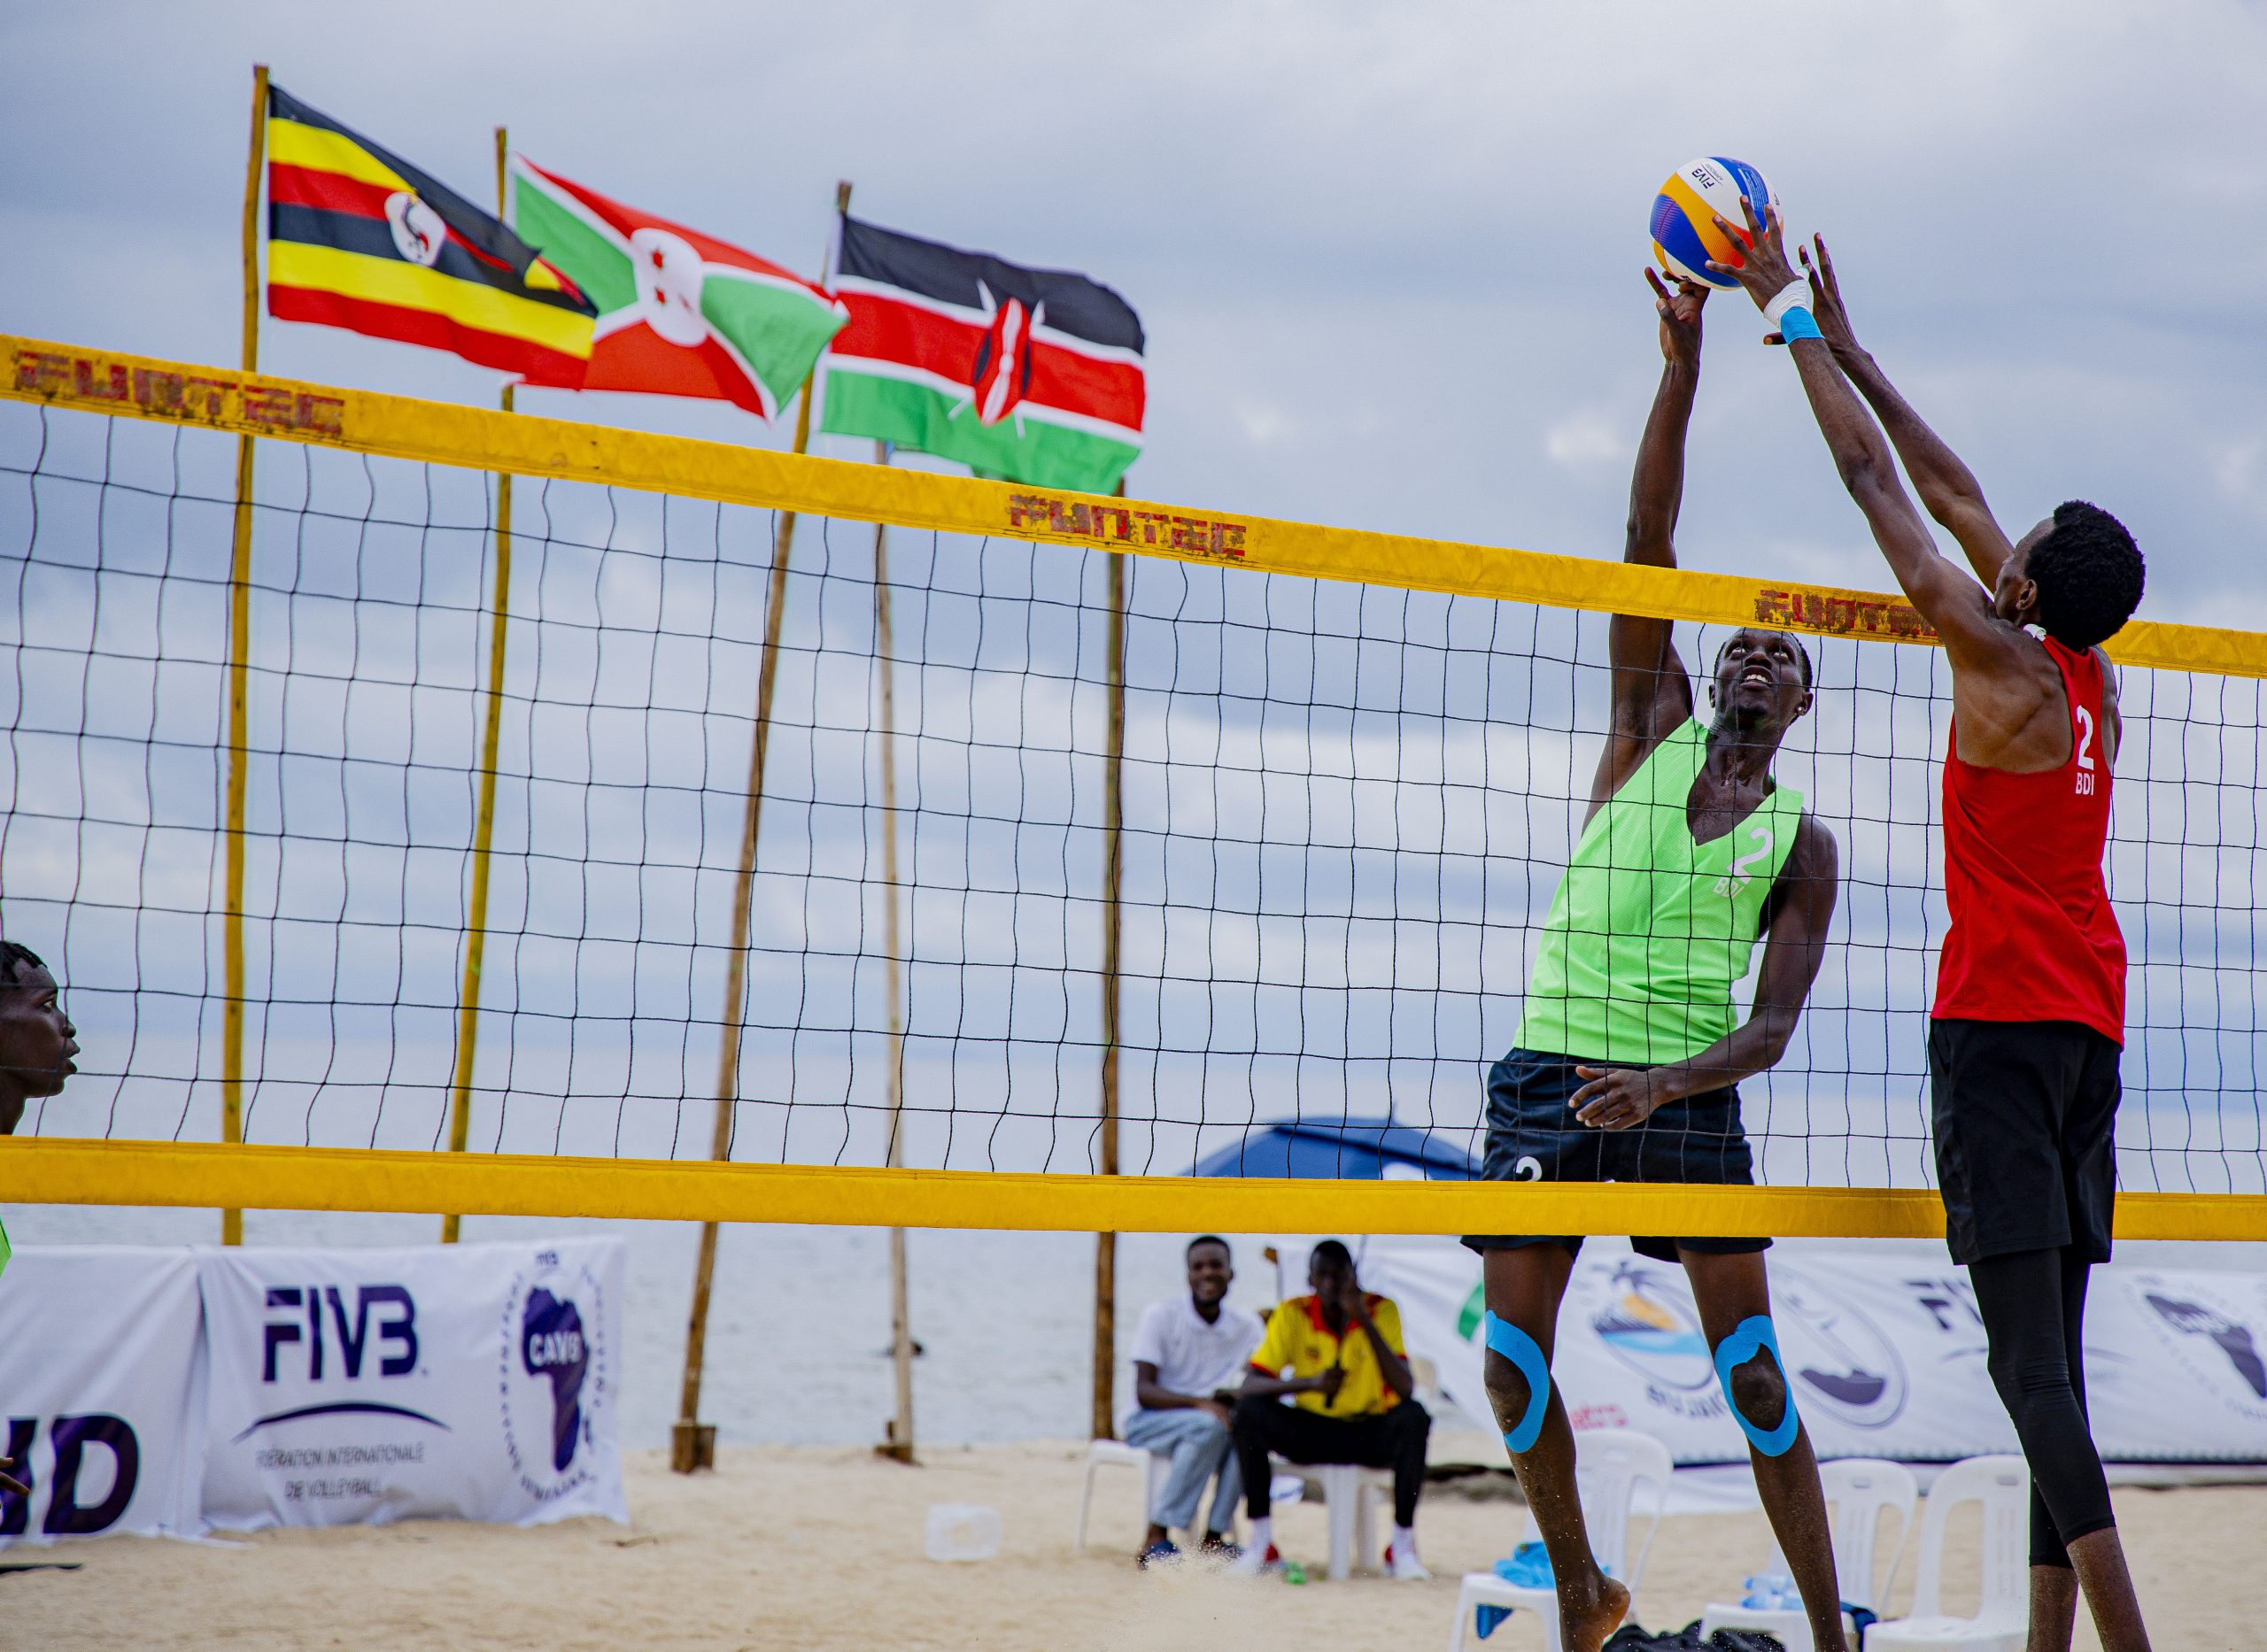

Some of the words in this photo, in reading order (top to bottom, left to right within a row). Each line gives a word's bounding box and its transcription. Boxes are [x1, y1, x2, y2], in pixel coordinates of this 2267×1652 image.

[1691, 167, 1715, 189] FIVB
[15, 350, 345, 437] FUNTEC
[1009, 494, 1247, 558] FUNTEC
[2076, 705, 2094, 770] 2
[2075, 772, 2095, 796] BDI
[1727, 827, 1775, 884] 2
[263, 1284, 420, 1383] FIVB
[529, 1328, 584, 1367] CAVB
[284, 1478, 305, 1501] DE
